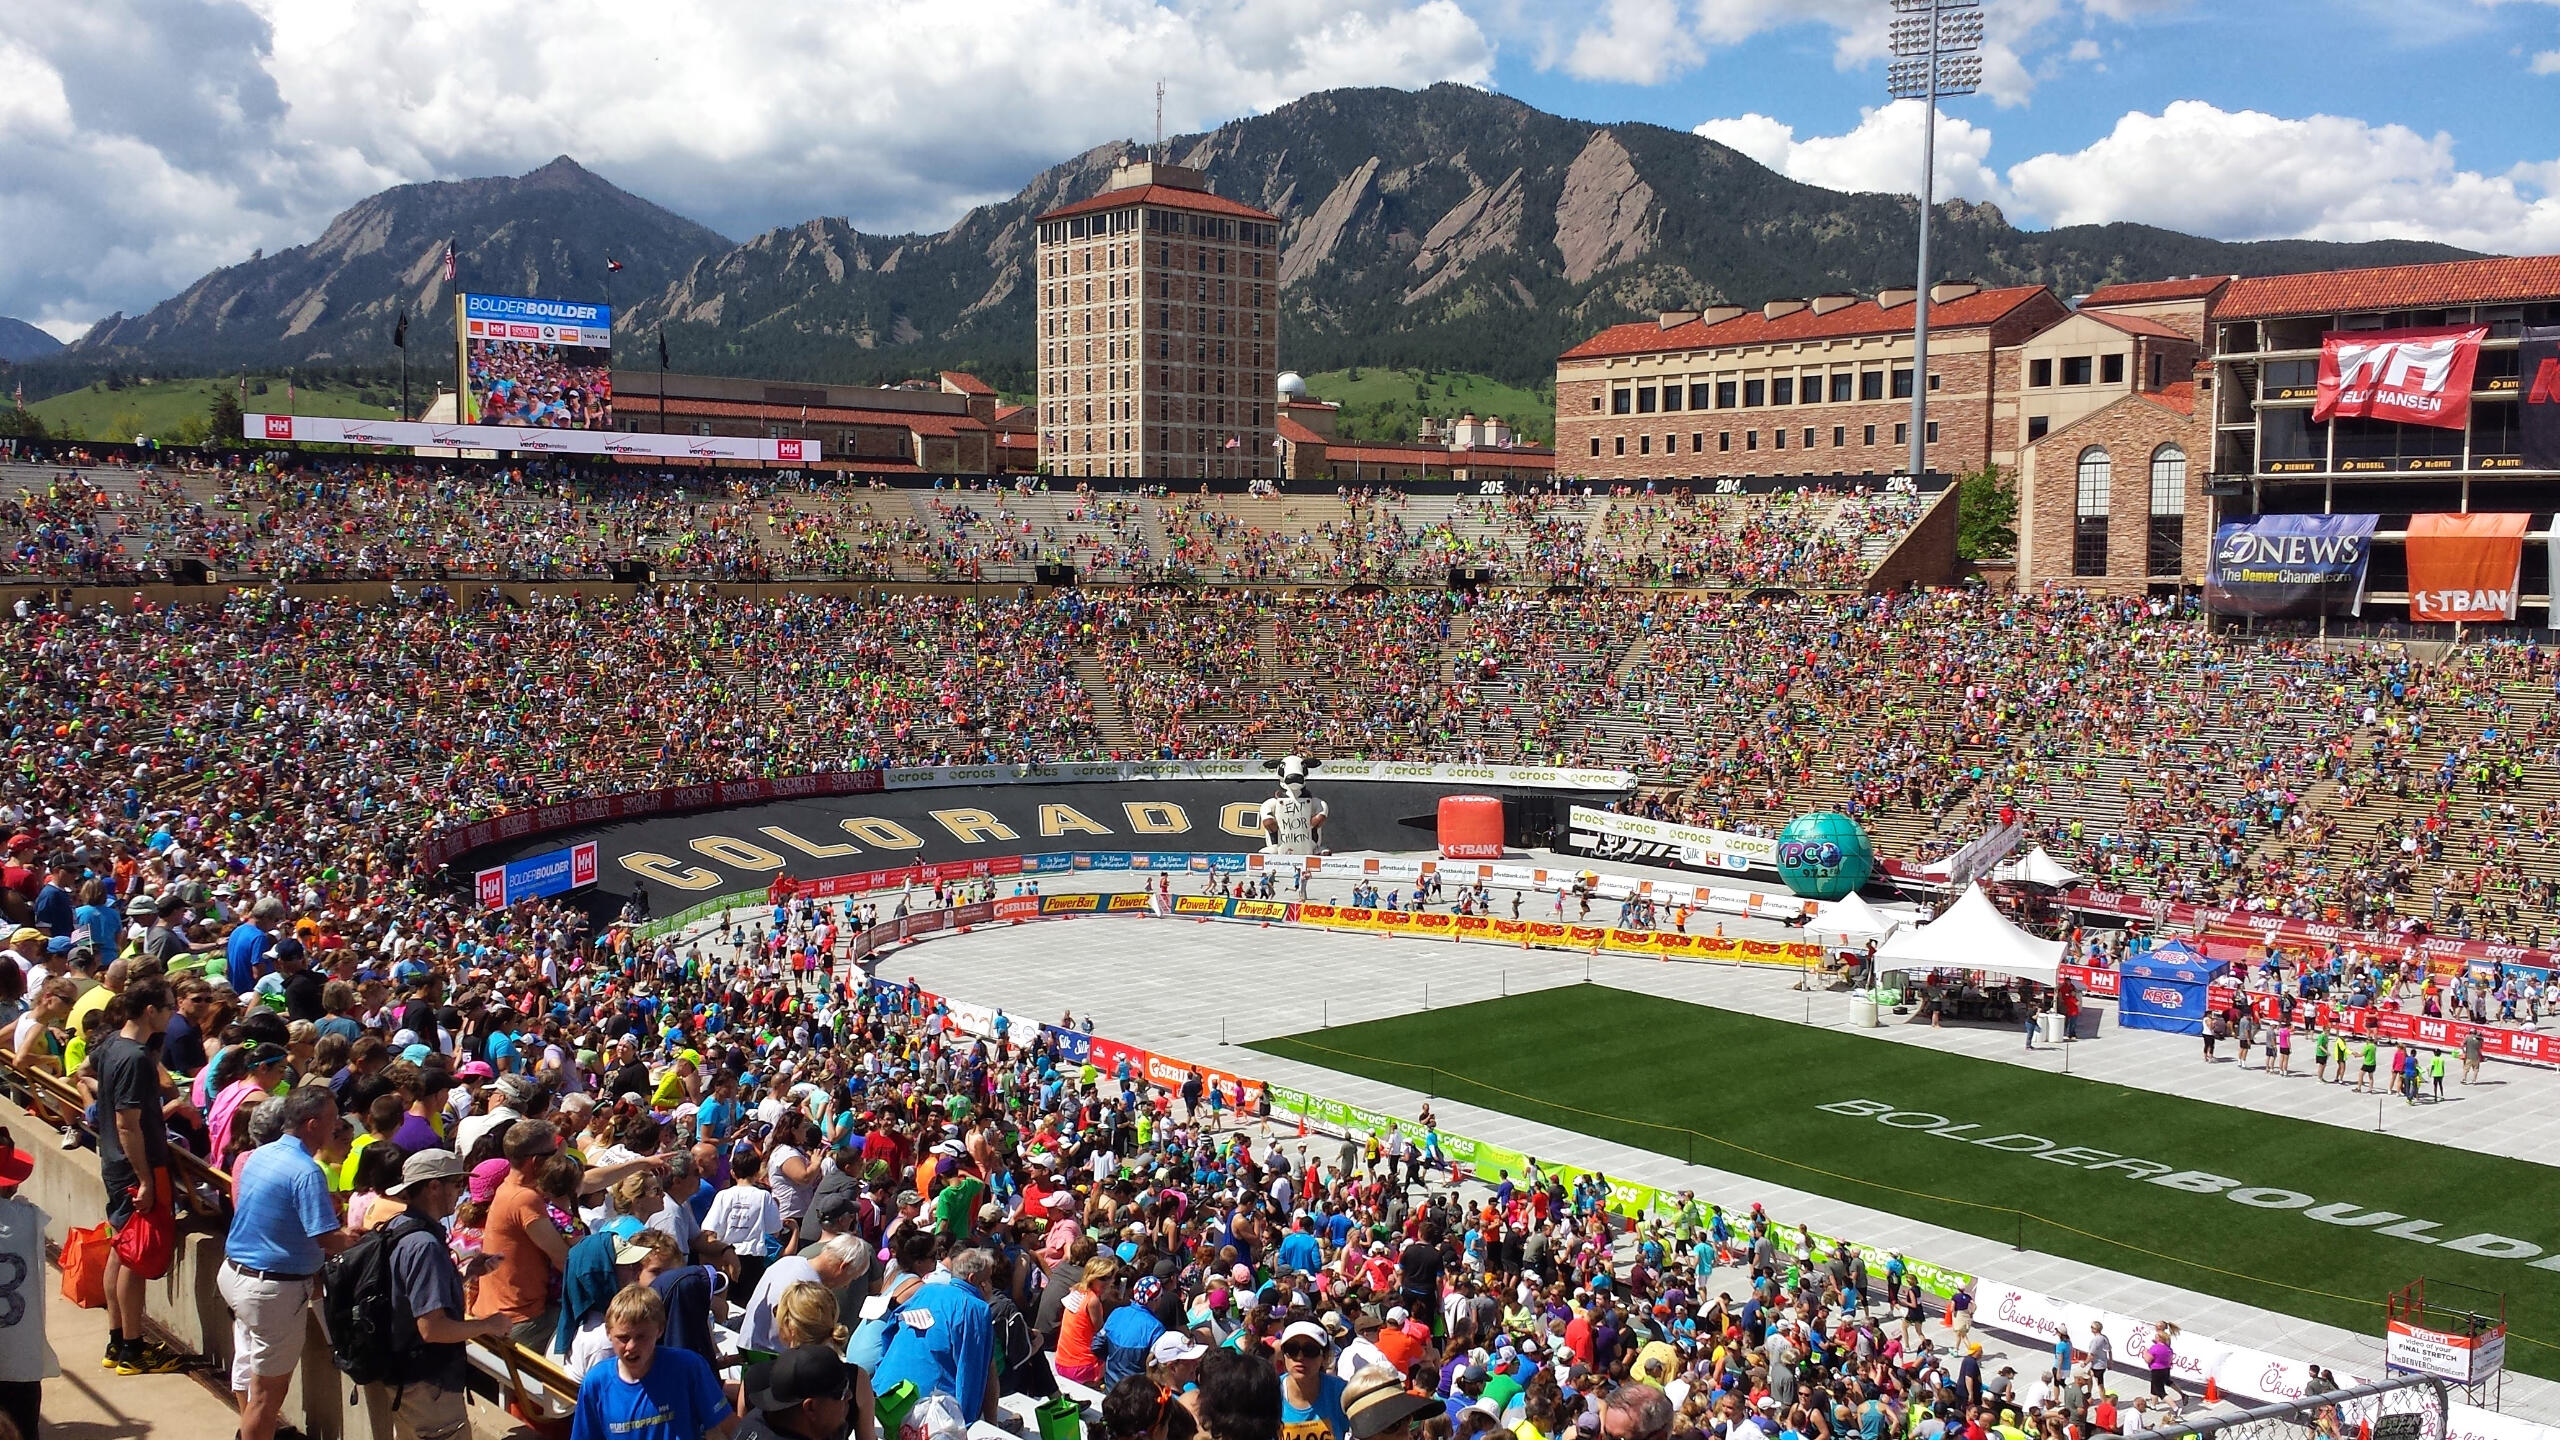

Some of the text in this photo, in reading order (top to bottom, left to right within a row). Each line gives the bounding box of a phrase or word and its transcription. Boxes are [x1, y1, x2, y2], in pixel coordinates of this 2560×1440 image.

[469, 297, 597, 320] BOLDERBOULDER
[2376, 391, 2441, 412] HANSEN
[2356, 461, 2385, 470] RUSSELL
[1480, 480, 1504, 494] 205
[1715, 479, 1741, 493] 204
[2219, 549, 2234, 560] abc
[2257, 536, 2359, 565] NEWS
[2221, 567, 2351, 585] TheDenverChannel.com
[958, 769, 996, 779] crocs
[1081, 766, 1118, 776] crocs
[1143, 765, 1181, 774] crocs
[1205, 764, 1244, 773] crocs
[1331, 765, 1370, 774] crocs
[1393, 765, 1432, 776] crocs
[1456, 768, 1494, 779] crocs
[772, 775, 816, 789] SPORTS
[831, 772, 876, 785] SPORTS
[897, 771, 934, 782] crocs
[1518, 770, 1556, 782] crocs
[1580, 774, 1617, 784] crocs
[721, 781, 760, 795] SPORTS
[1282, 817, 1308, 830] MOR
[1572, 812, 1605, 826] crocs
[1624, 822, 1657, 835] crocs
[1677, 830, 1712, 845] crocs
[618, 801, 1266, 891] COLORADO
[1448, 844, 1498, 855] 1STBANK
[1734, 840, 1770, 854] crocs
[577, 852, 593, 872] HH
[973, 861, 988, 873] HH
[1264, 859, 1303, 868] efirstbank.com
[1321, 862, 1360, 870] efirstbank.com
[1380, 864, 1419, 872] efirstbank.com
[1900, 862, 1922, 873] ROO
[509, 860, 570, 888] BOLDERBOULDER
[870, 873, 886, 885] HH
[922, 867, 937, 878] HH
[1493, 871, 1530, 880] efirstbank.com
[482, 877, 500, 900] HH
[819, 881, 835, 893] HH
[1046, 897, 1094, 911] PowerBar
[1112, 895, 1148, 908] PowerB
[1179, 897, 1223, 911] PowerBar
[2089, 891, 2123, 905] ROOT
[1004, 901, 1038, 913] SERIES
[1238, 902, 1283, 917] PowerBar
[2248, 915, 2287, 931] ROOT
[2305, 923, 2341, 938] ROOT
[2425, 937, 2466, 953] ROOT
[2485, 945, 2529, 959] ROOT
[2091, 971, 2115, 987] HH
[2420, 1020, 2447, 1038] HH
[1057, 1034, 1072, 1050] Silk
[1074, 1039, 1090, 1055] Silk
[2511, 1034, 2539, 1052] HH
[1148, 1057, 1160, 1079] G
[1160, 1065, 1187, 1082] SERI
[1275, 1087, 1305, 1105] crocs
[1357, 1111, 1387, 1127] crocs
[2409, 1327, 2448, 1345] Watch
[2398, 1343, 2457, 1362] FINAL STRETCH
[2405, 1338, 2424, 1348] video
[2434, 1345, 2451, 1354] your
[2391, 1353, 2466, 1378] TheDENVERChannel.com
